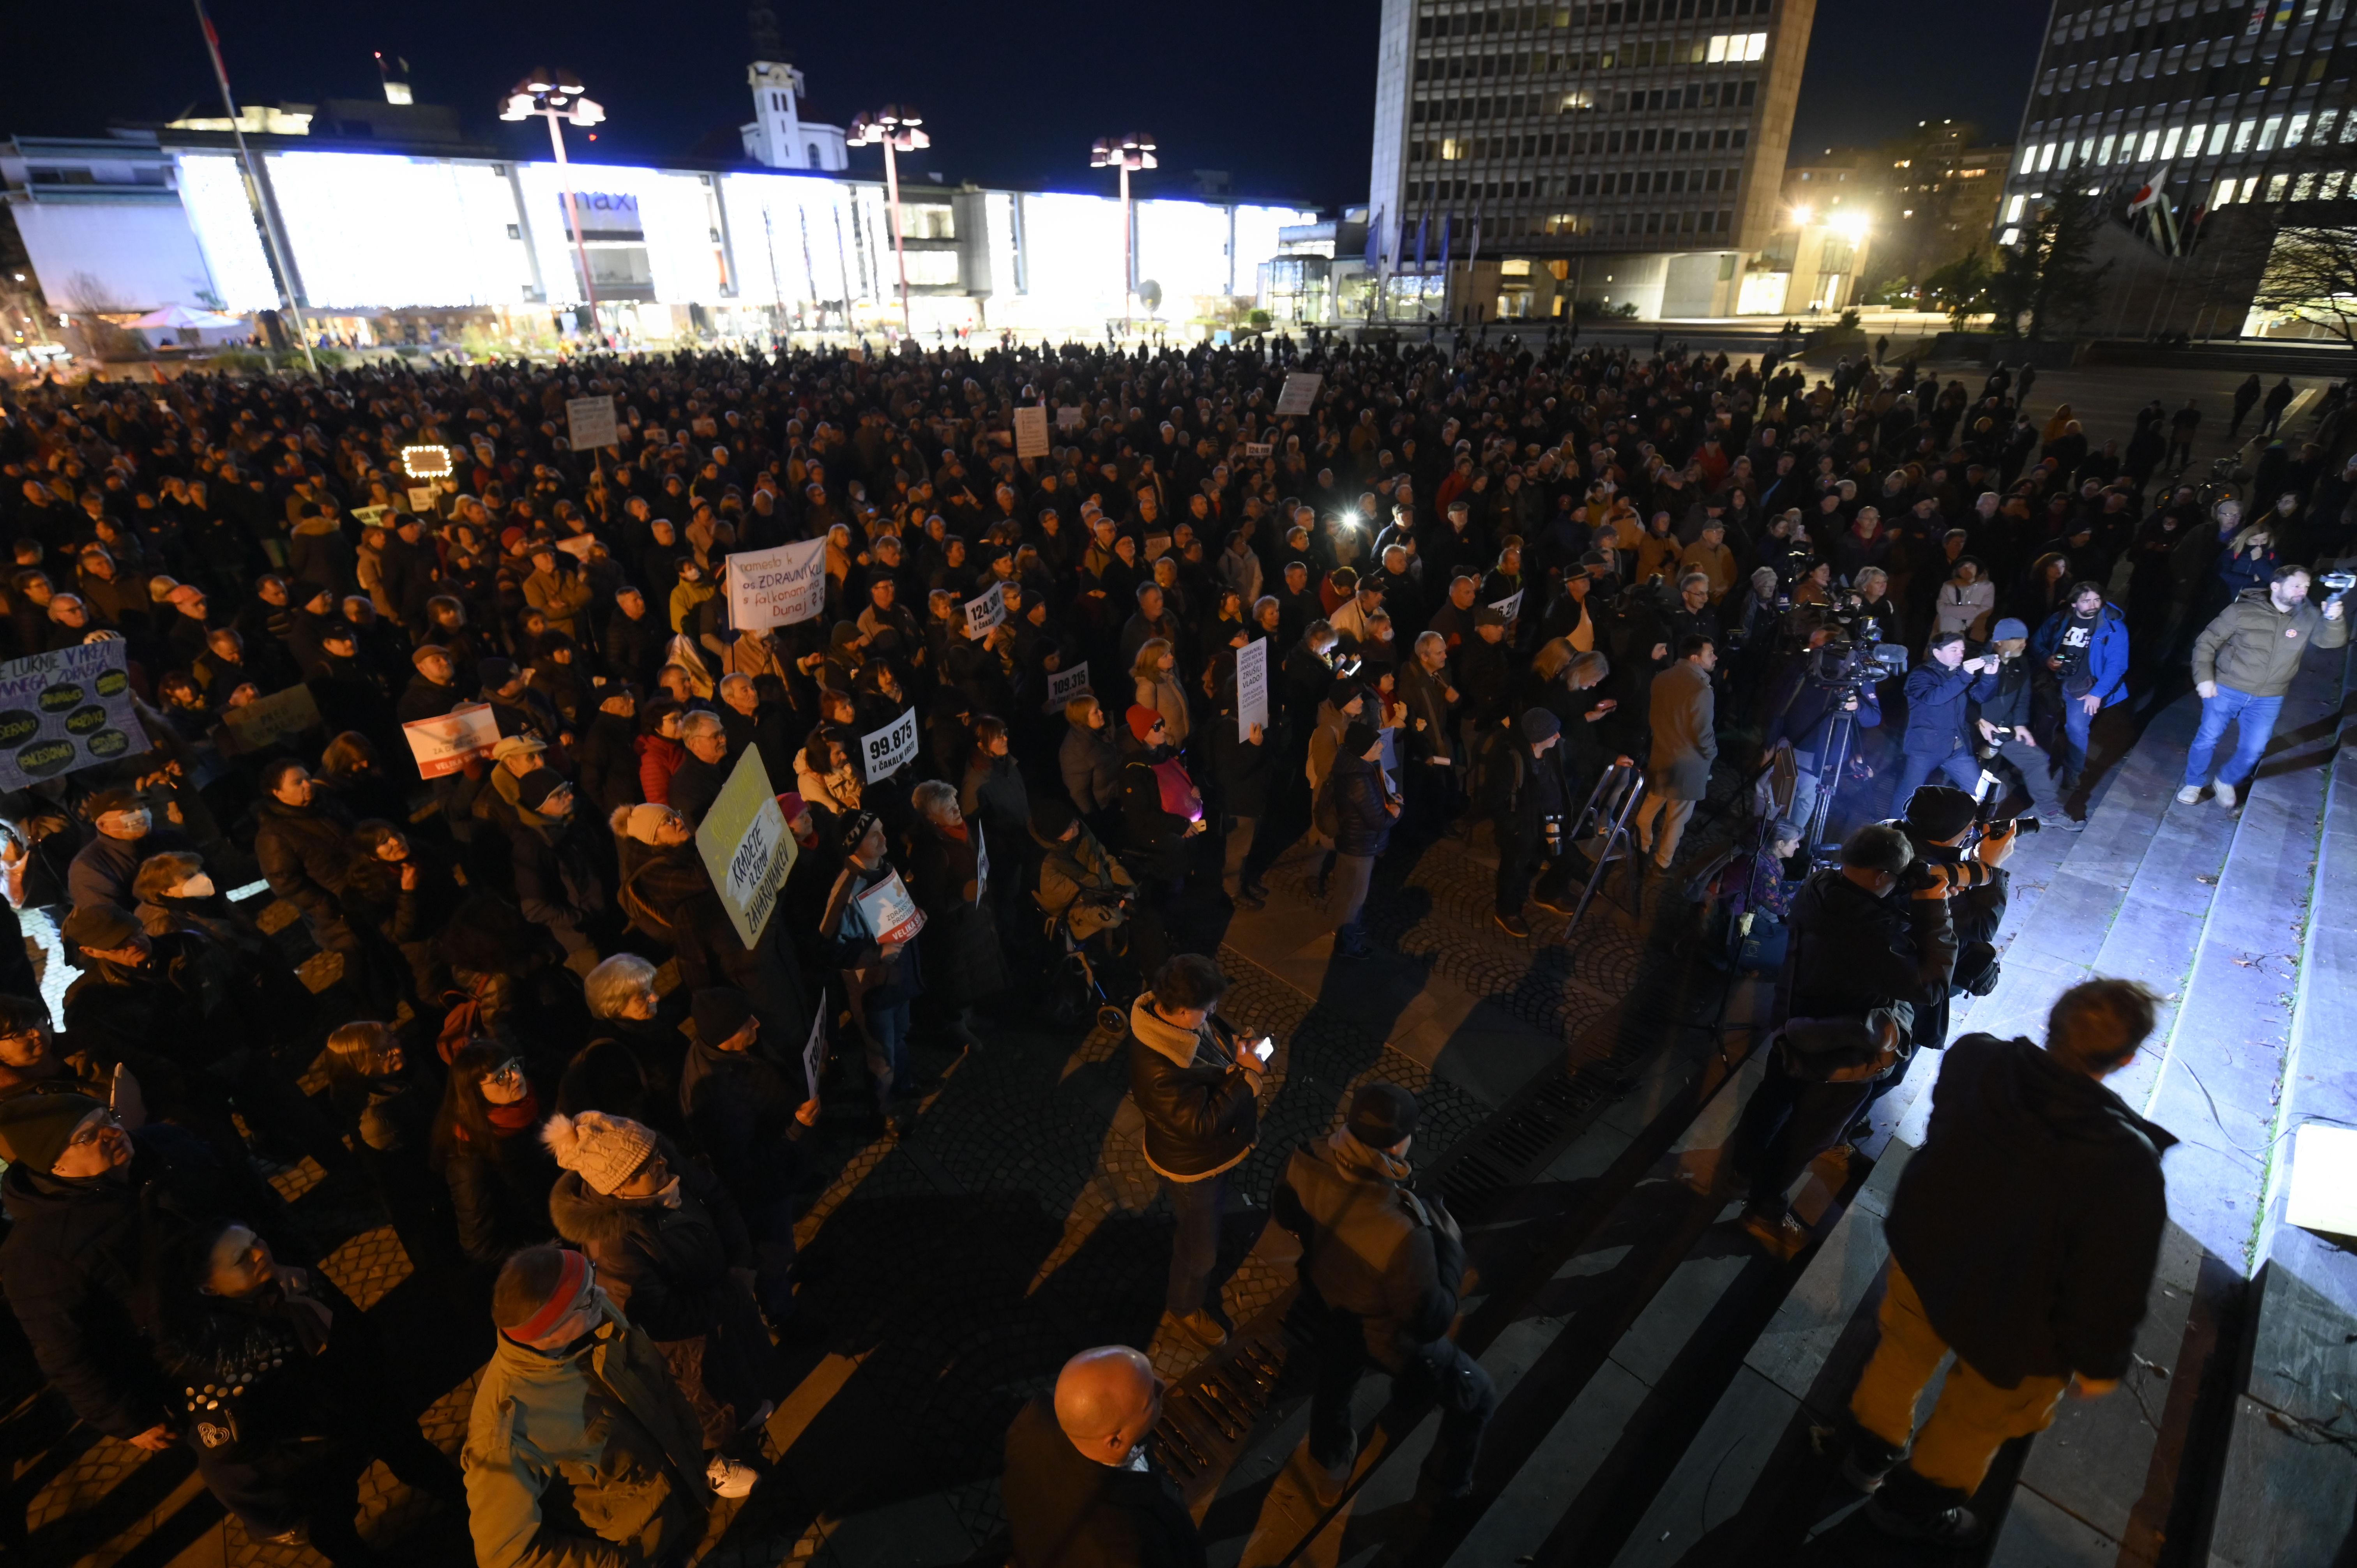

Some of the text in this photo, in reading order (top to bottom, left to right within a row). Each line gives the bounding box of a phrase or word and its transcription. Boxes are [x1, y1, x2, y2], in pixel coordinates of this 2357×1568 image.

[741, 552, 792, 572] namesto k
[758, 564, 822, 589] ZDRAVNIKU
[773, 598, 807, 616] Dunaj
[65, 648, 76, 665] V
[1241, 657, 1251, 665] BOSTE
[1242, 664, 1262, 680] ZRUŠILI
[1242, 673, 1263, 689] VLADO?
[1053, 669, 1086, 695] 109.315
[869, 719, 912, 759] 99.875
[879, 752, 904, 770] ČAKALNI
[904, 740, 914, 756] VRSTI
[731, 815, 763, 889] KRADETE
[892, 921, 915, 940] VELIKA
